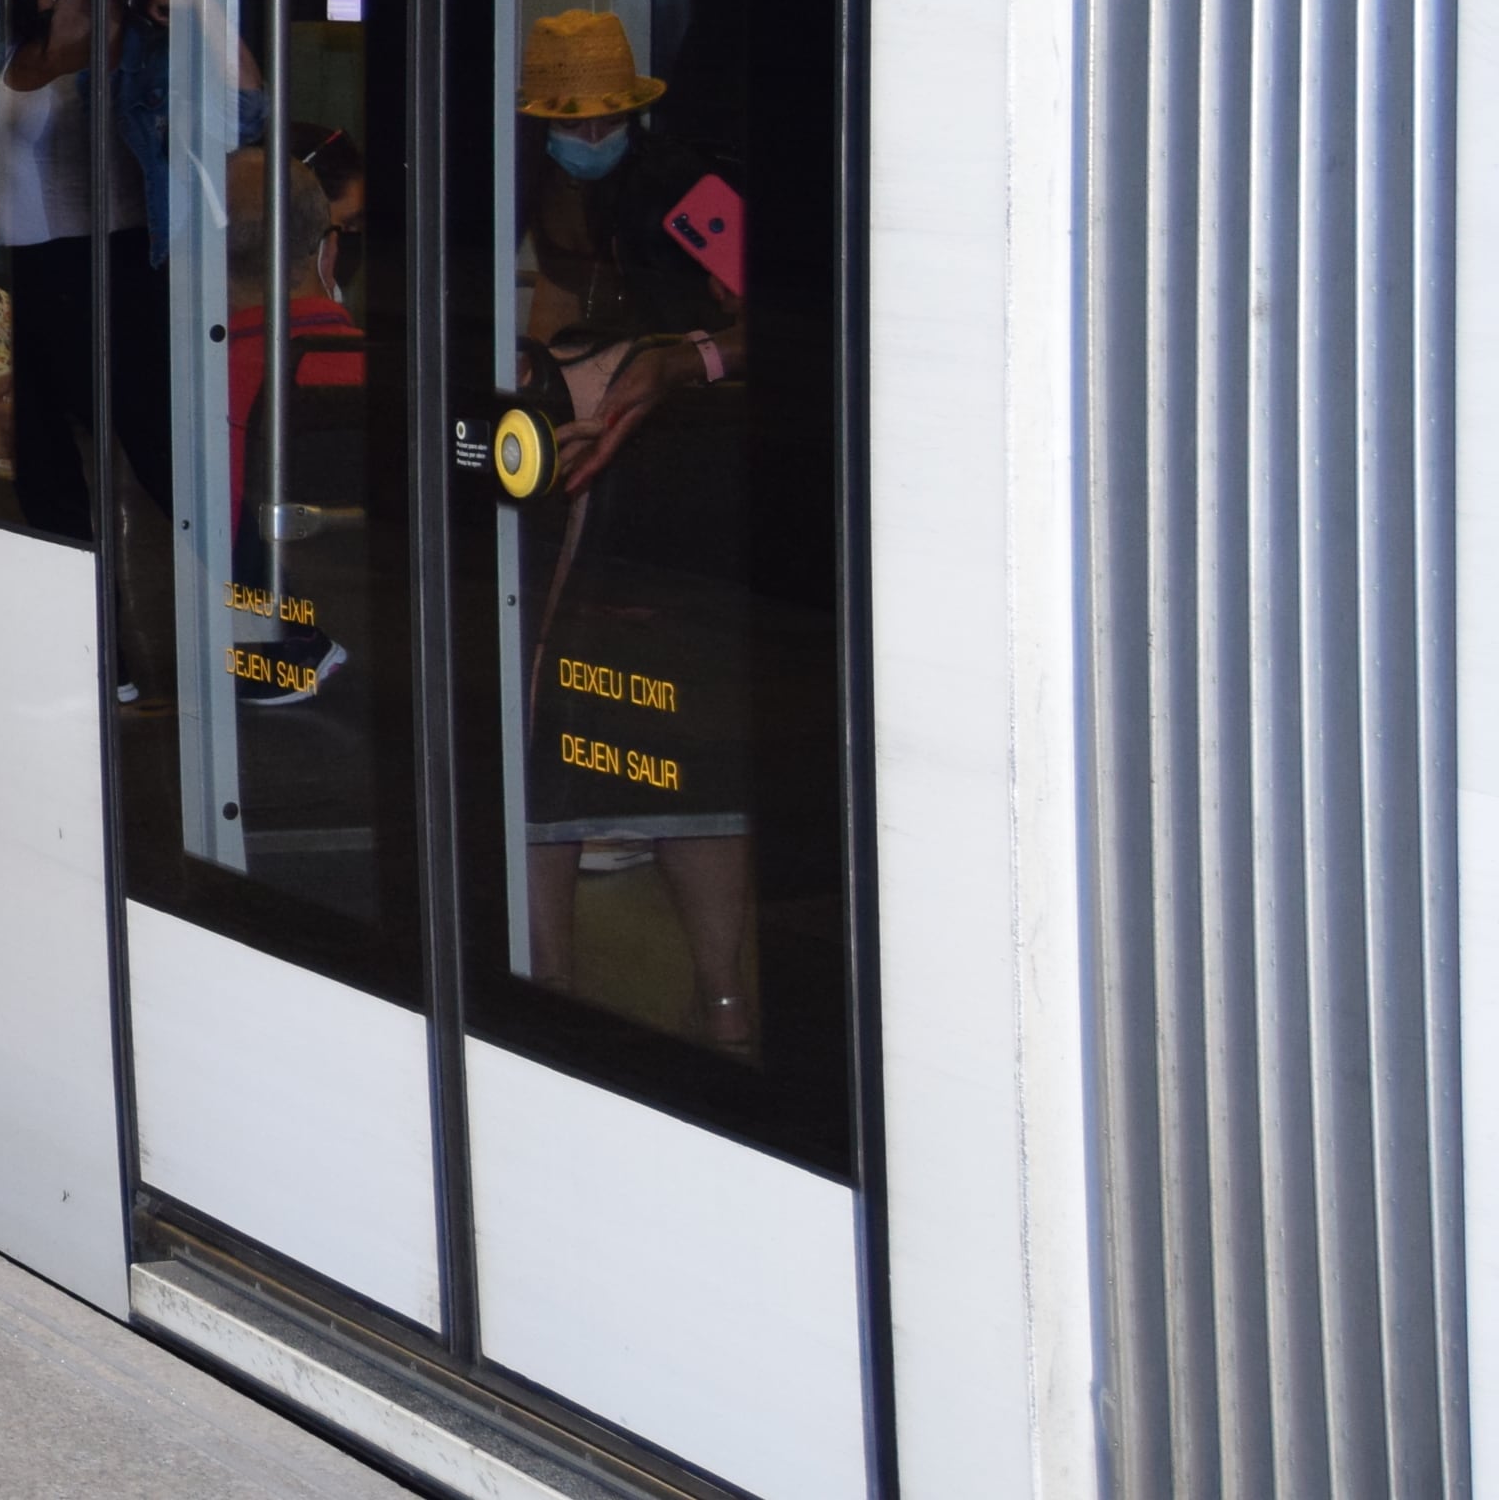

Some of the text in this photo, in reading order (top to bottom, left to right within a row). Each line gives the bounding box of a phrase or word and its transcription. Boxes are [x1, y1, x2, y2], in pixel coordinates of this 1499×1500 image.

[224, 581, 275, 618] DEIXEU
[226, 647, 318, 696] DEJEN SALIR
[559, 658, 623, 700] DEIXEU
[562, 733, 679, 791] DEJEN SALIR
